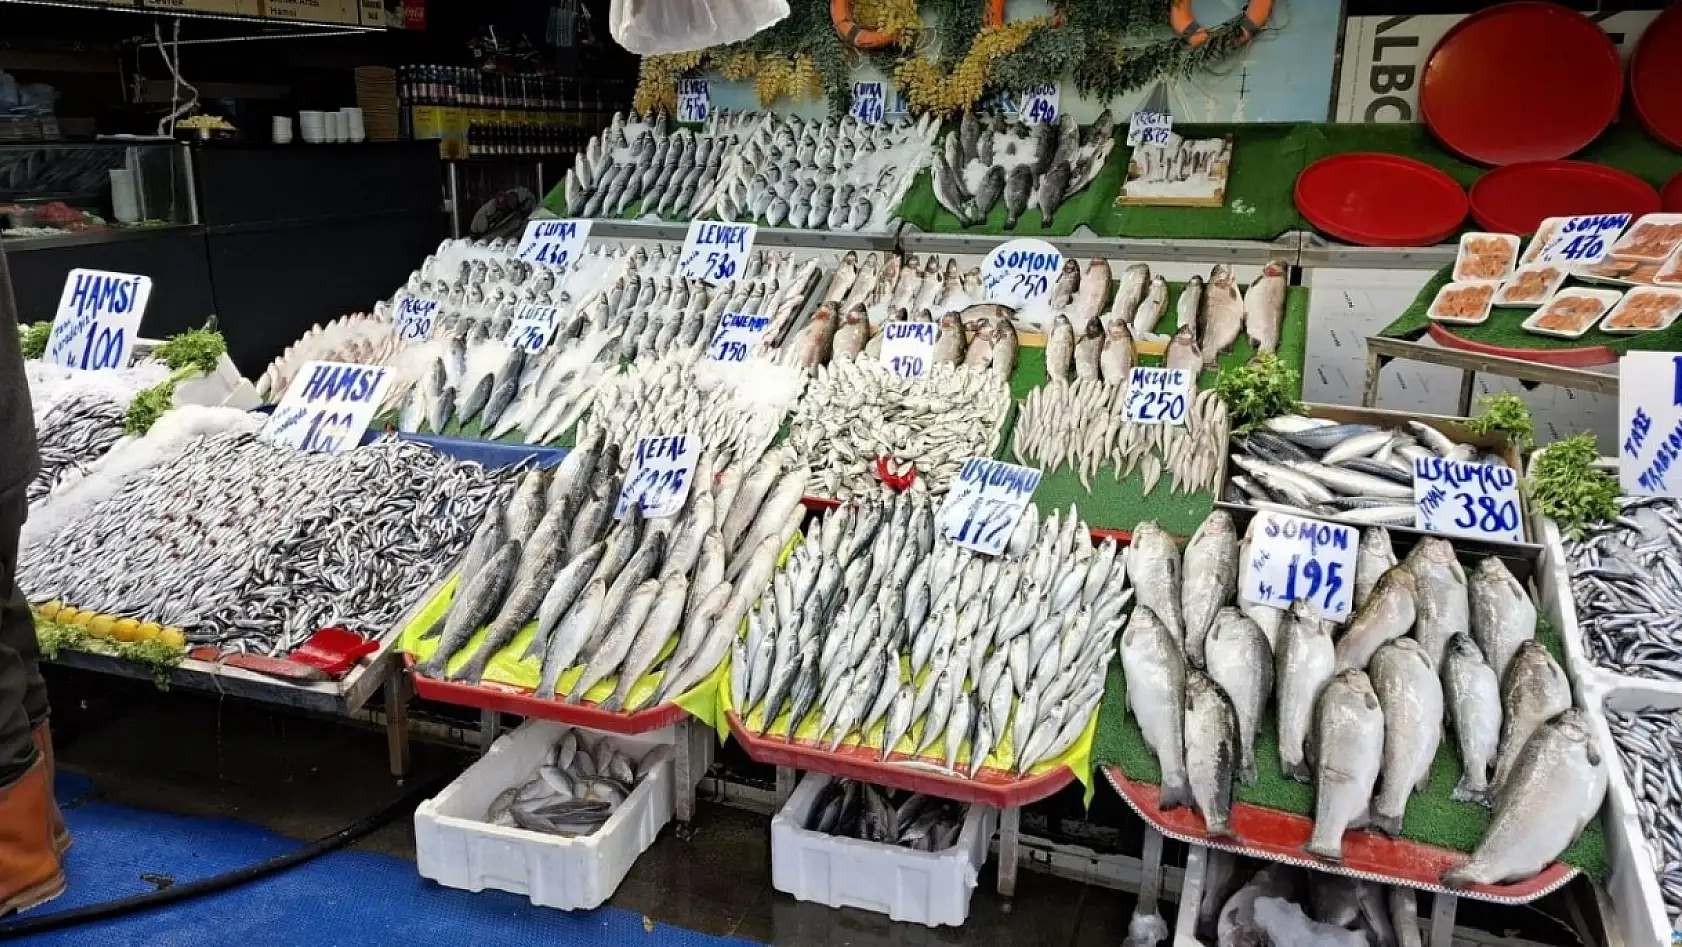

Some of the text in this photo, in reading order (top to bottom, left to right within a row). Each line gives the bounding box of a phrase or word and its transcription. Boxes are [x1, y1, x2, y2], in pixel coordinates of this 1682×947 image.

[1029, 98, 1055, 123] 490
[696, 224, 749, 253] LEVREK
[1563, 214, 1631, 234] SOMON
[994, 250, 1060, 273] SOMON
[1560, 234, 1604, 260] 470
[1011, 273, 1048, 299] 250
[80, 321, 125, 370] 100
[717, 341, 747, 362] 150
[890, 356, 923, 378] 150
[1138, 391, 1185, 420] 250
[635, 436, 687, 469] KEFAL
[960, 457, 1041, 500] USKUMRU
[1416, 456, 1514, 495] USKUMRU
[1454, 492, 1520, 532] 380
[1264, 517, 1349, 556] SOMON
[1279, 552, 1343, 610] 195
